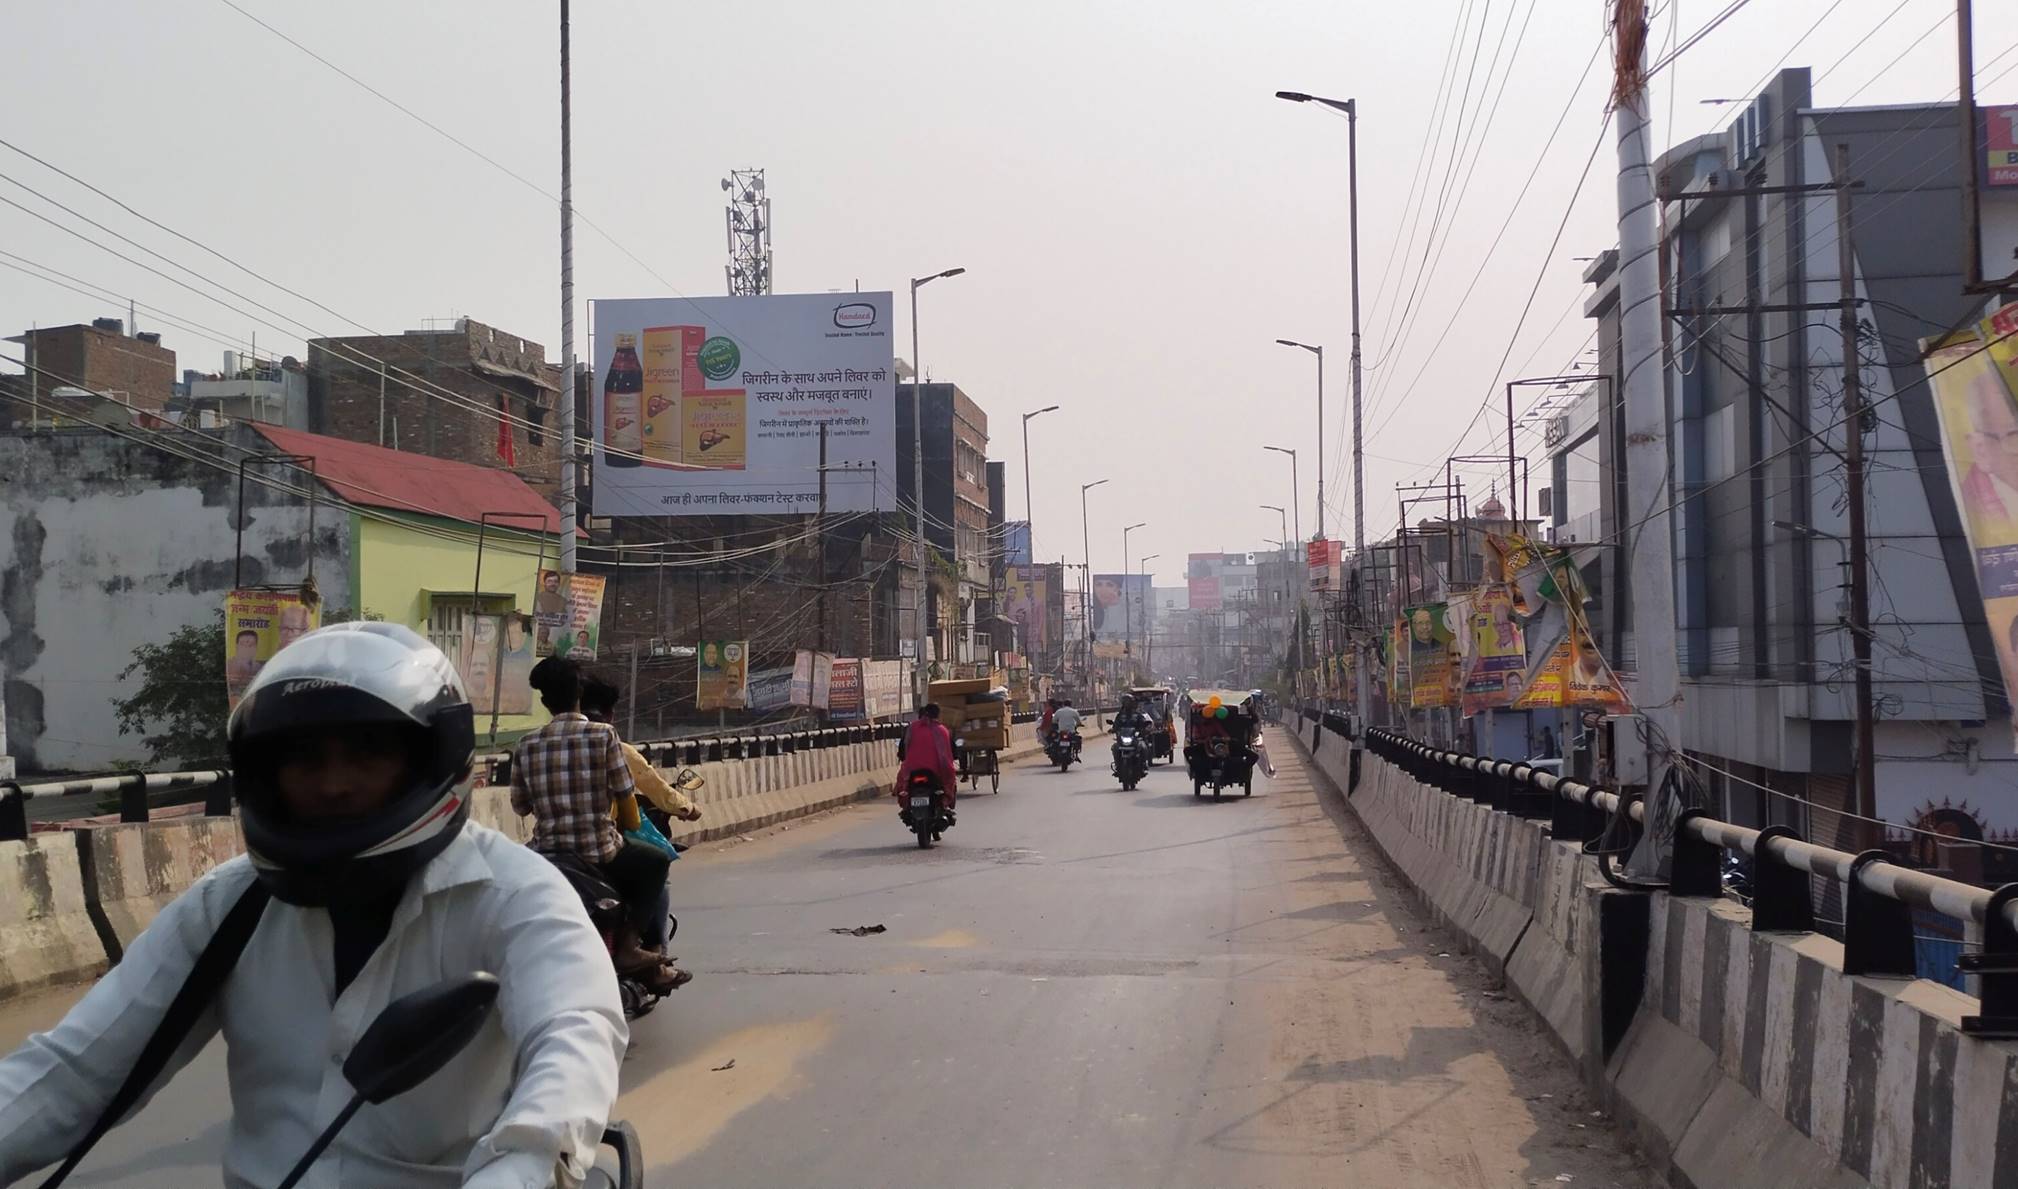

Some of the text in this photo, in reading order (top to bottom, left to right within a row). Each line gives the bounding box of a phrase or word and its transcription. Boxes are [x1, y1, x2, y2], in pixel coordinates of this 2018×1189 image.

[742, 371, 779, 385] जिगरीन
[781, 370, 792, 384] के
[794, 372, 815, 384] साथ
[817, 369, 842, 383] अपने
[844, 368, 869, 382] लिवर
[872, 368, 887, 382] को
[756, 391, 784, 402] स्वस्थ
[785, 387, 805, 401] और
[661, 494, 681, 505] आज
[682, 493, 692, 505] ही
[694, 494, 717, 504] अपना
